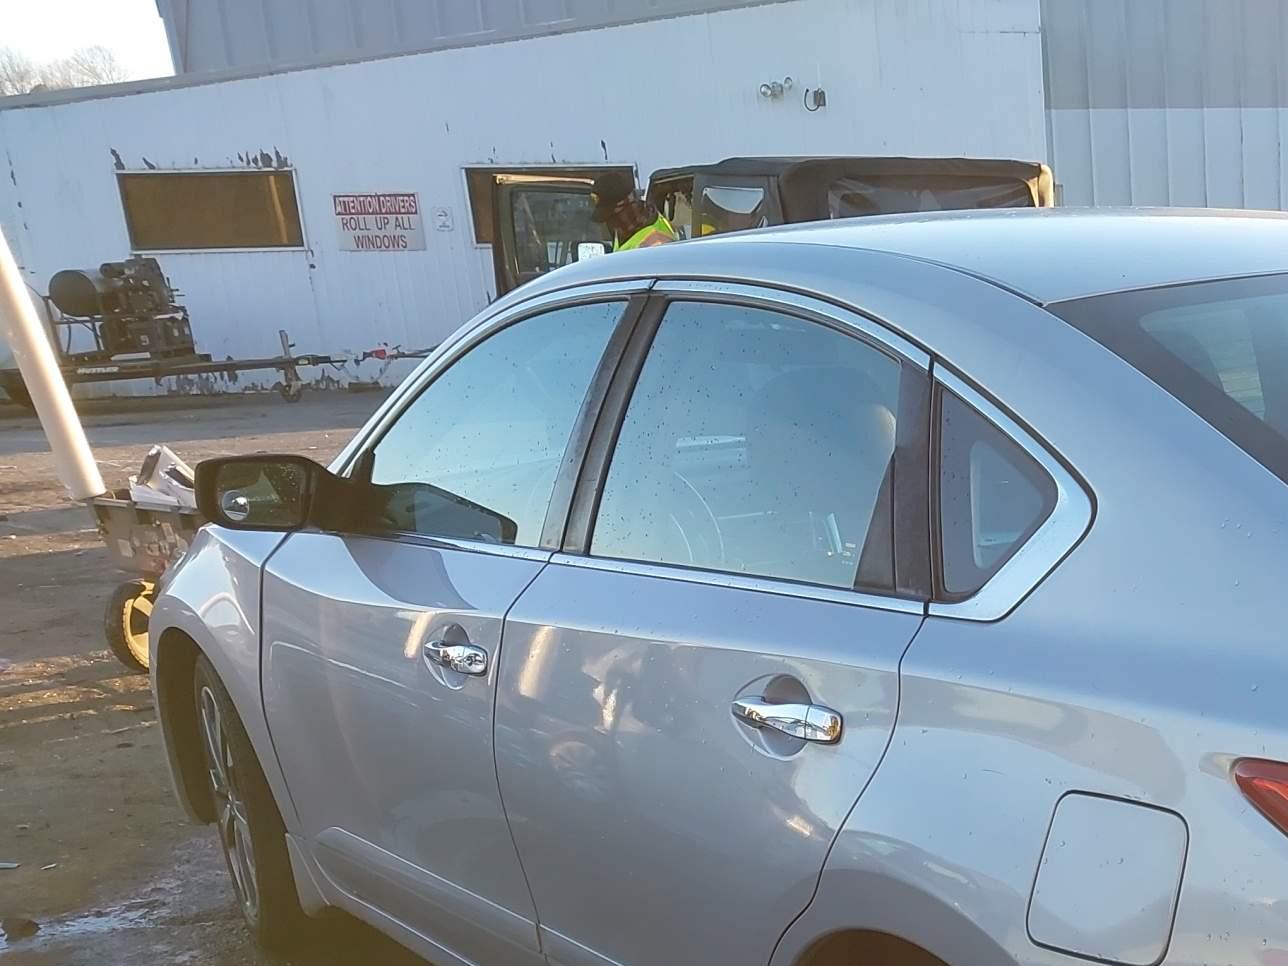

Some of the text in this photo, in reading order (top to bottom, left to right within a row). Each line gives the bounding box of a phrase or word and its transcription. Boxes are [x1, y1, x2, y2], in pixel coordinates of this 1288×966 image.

[335, 196, 416, 214] ATTENTION DRIVERS
[341, 217, 371, 231] ROLL
[375, 217, 390, 230] UP
[394, 216, 416, 230] ALL
[353, 235, 408, 249] WINDOWS
